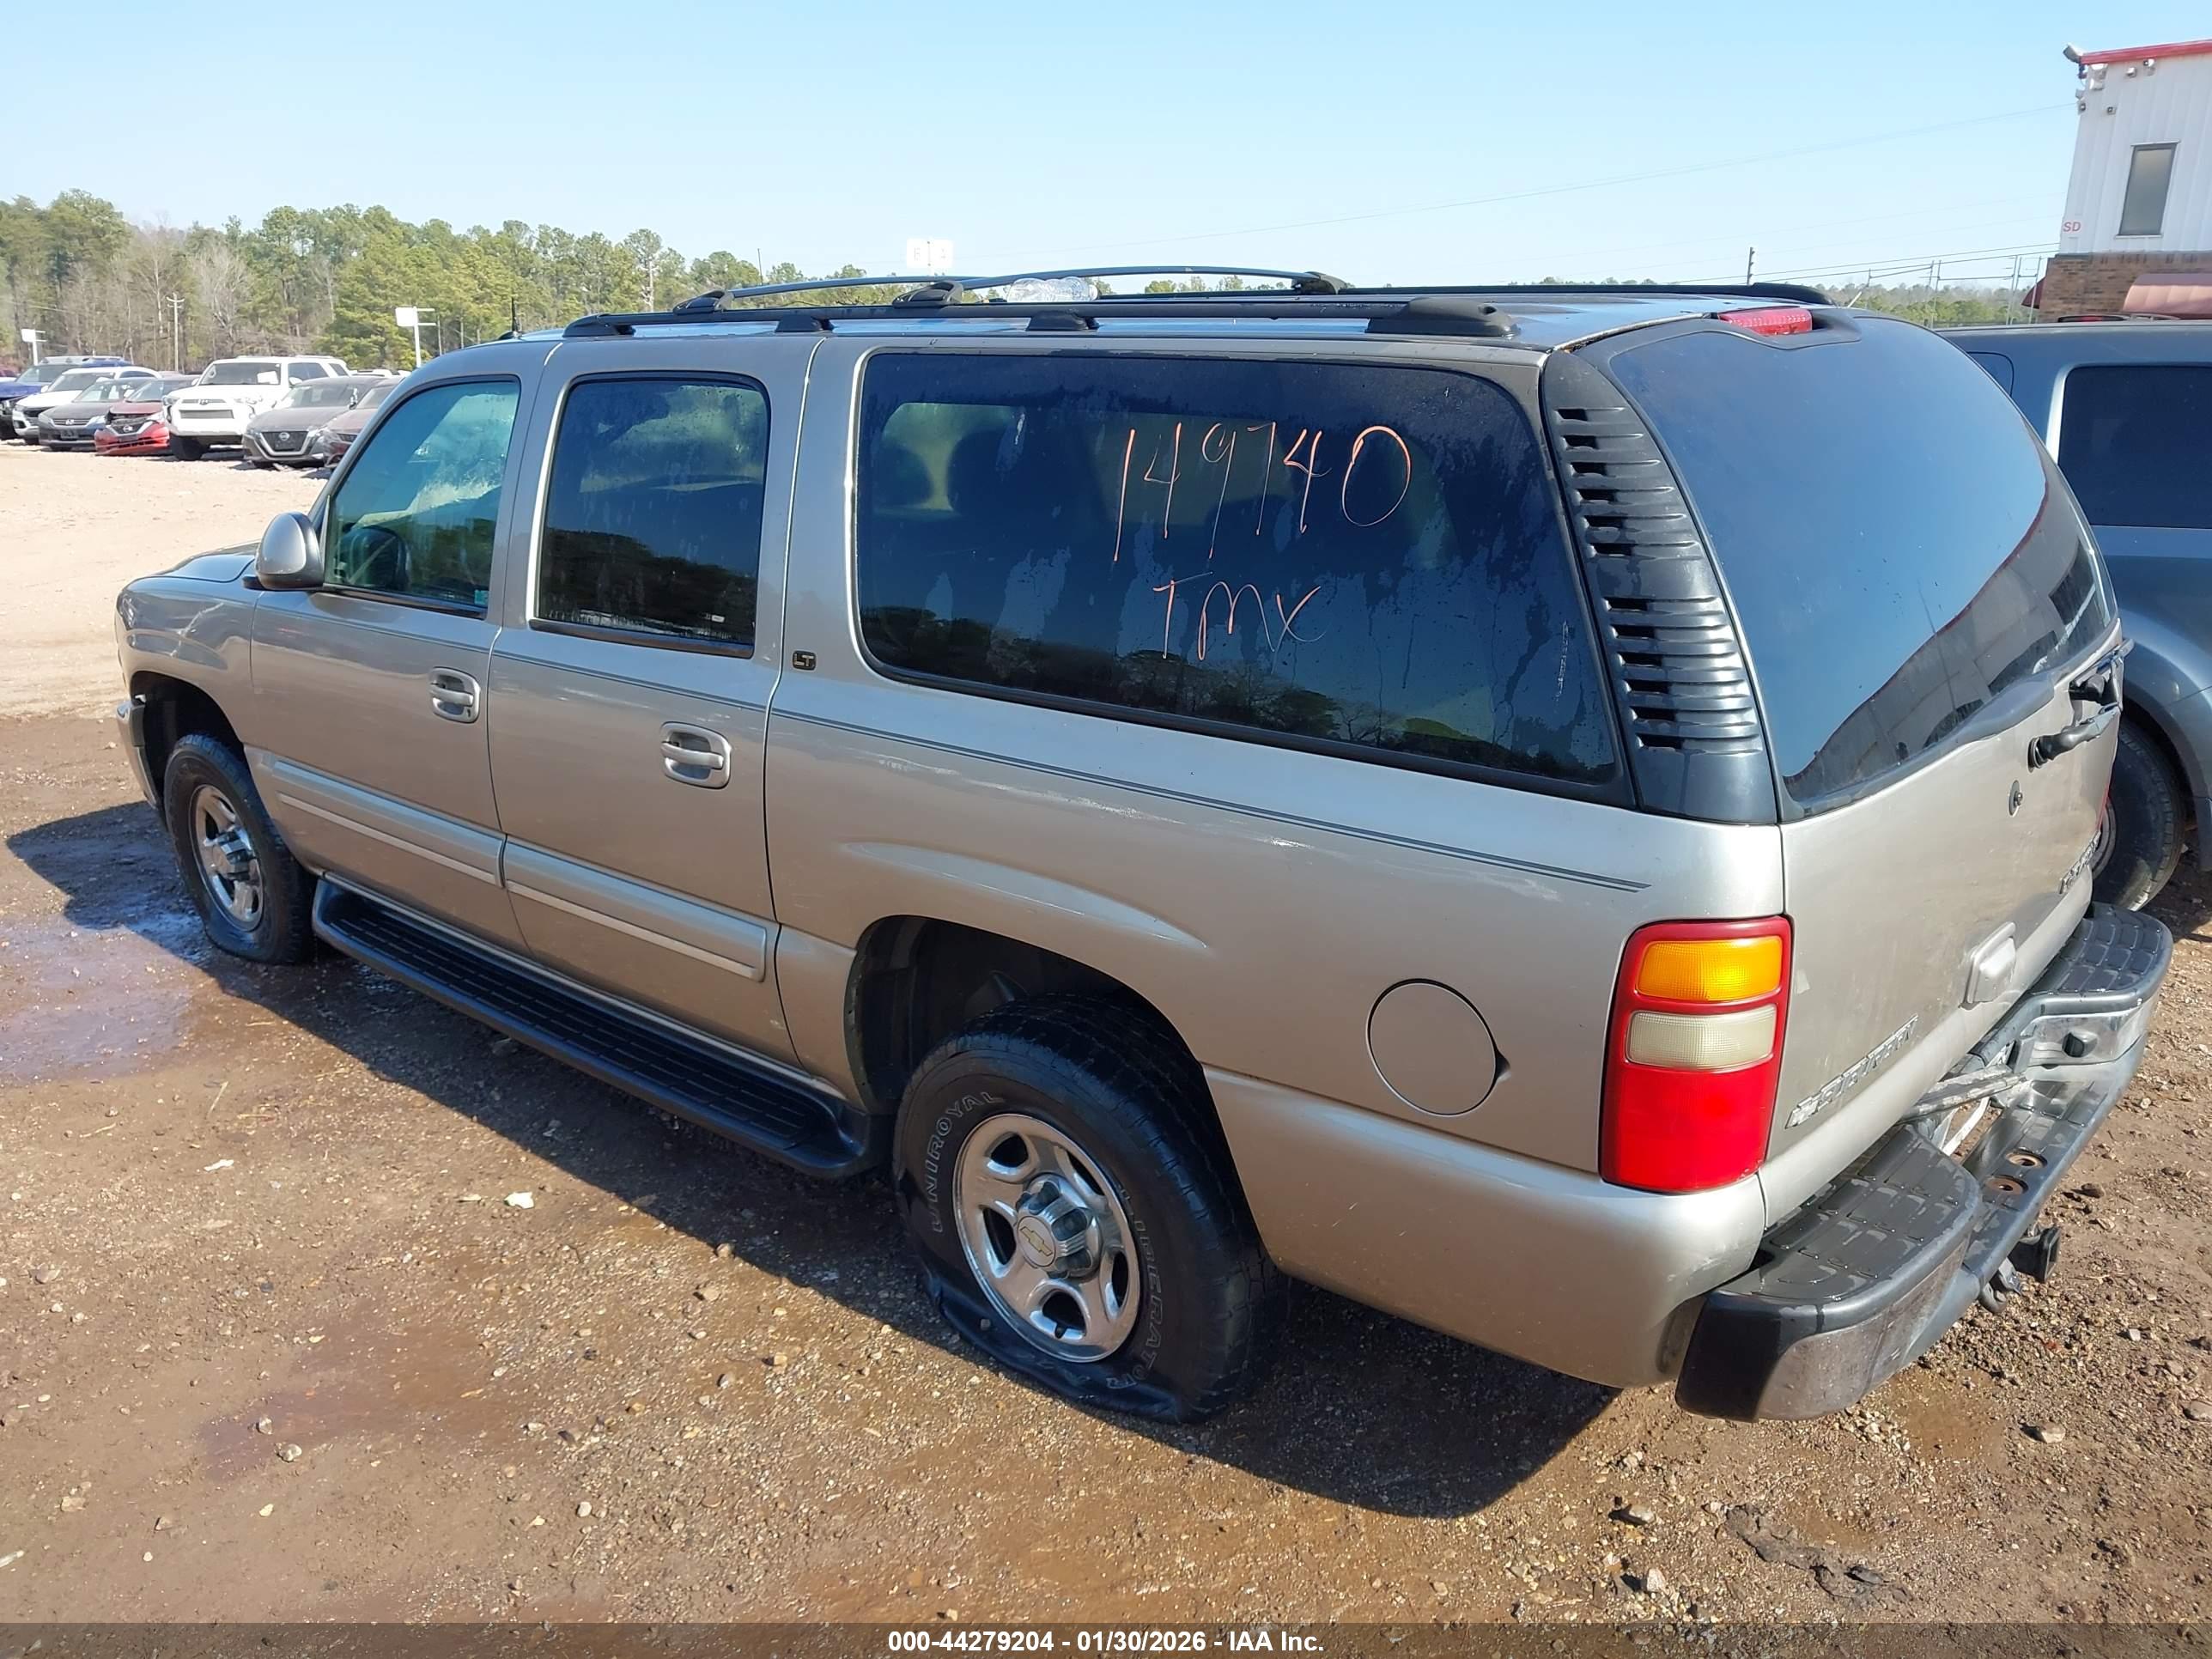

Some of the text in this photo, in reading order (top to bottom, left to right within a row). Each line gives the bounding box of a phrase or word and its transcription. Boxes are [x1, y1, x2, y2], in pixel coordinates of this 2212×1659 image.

[2063, 221, 2081, 233] SD
[1114, 422, 1411, 562] 149740
[793, 653, 814, 667] LT
[925, 1091, 1006, 1233] UNIROYAL
